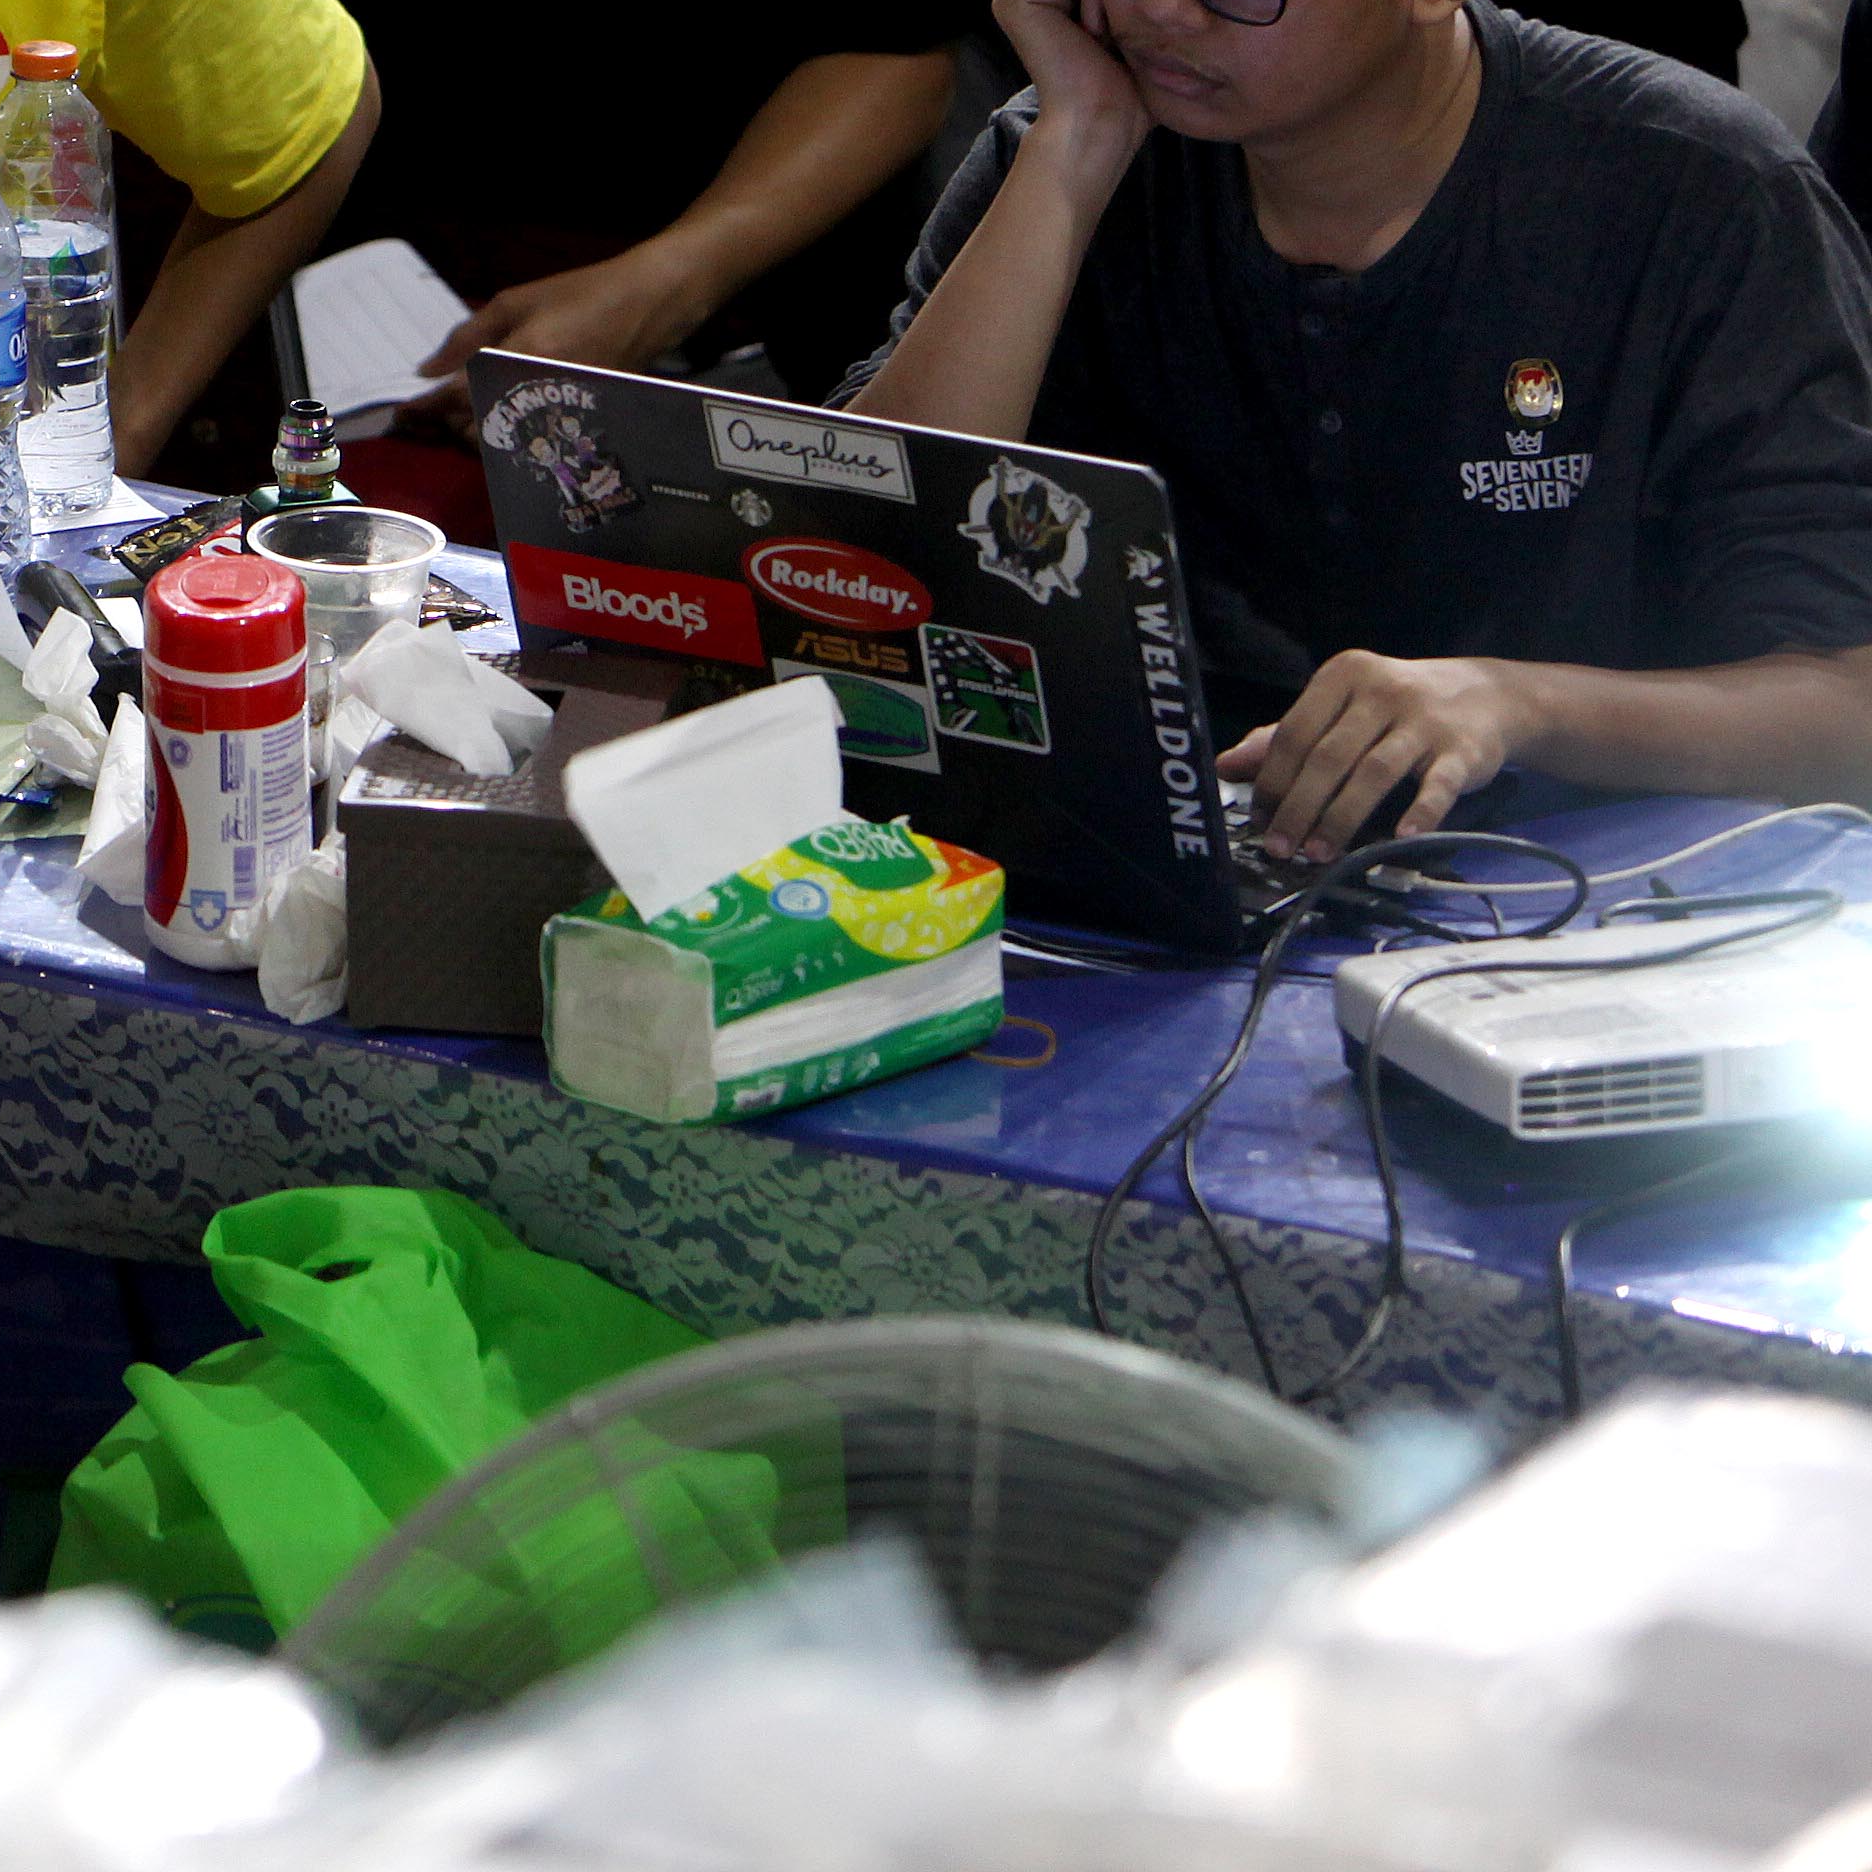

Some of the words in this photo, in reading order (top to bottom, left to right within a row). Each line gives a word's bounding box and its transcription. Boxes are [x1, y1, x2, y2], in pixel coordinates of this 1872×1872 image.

[727, 418, 897, 480] Oneplus
[562, 574, 709, 640] Bloods
[793, 630, 910, 674] ASUS
